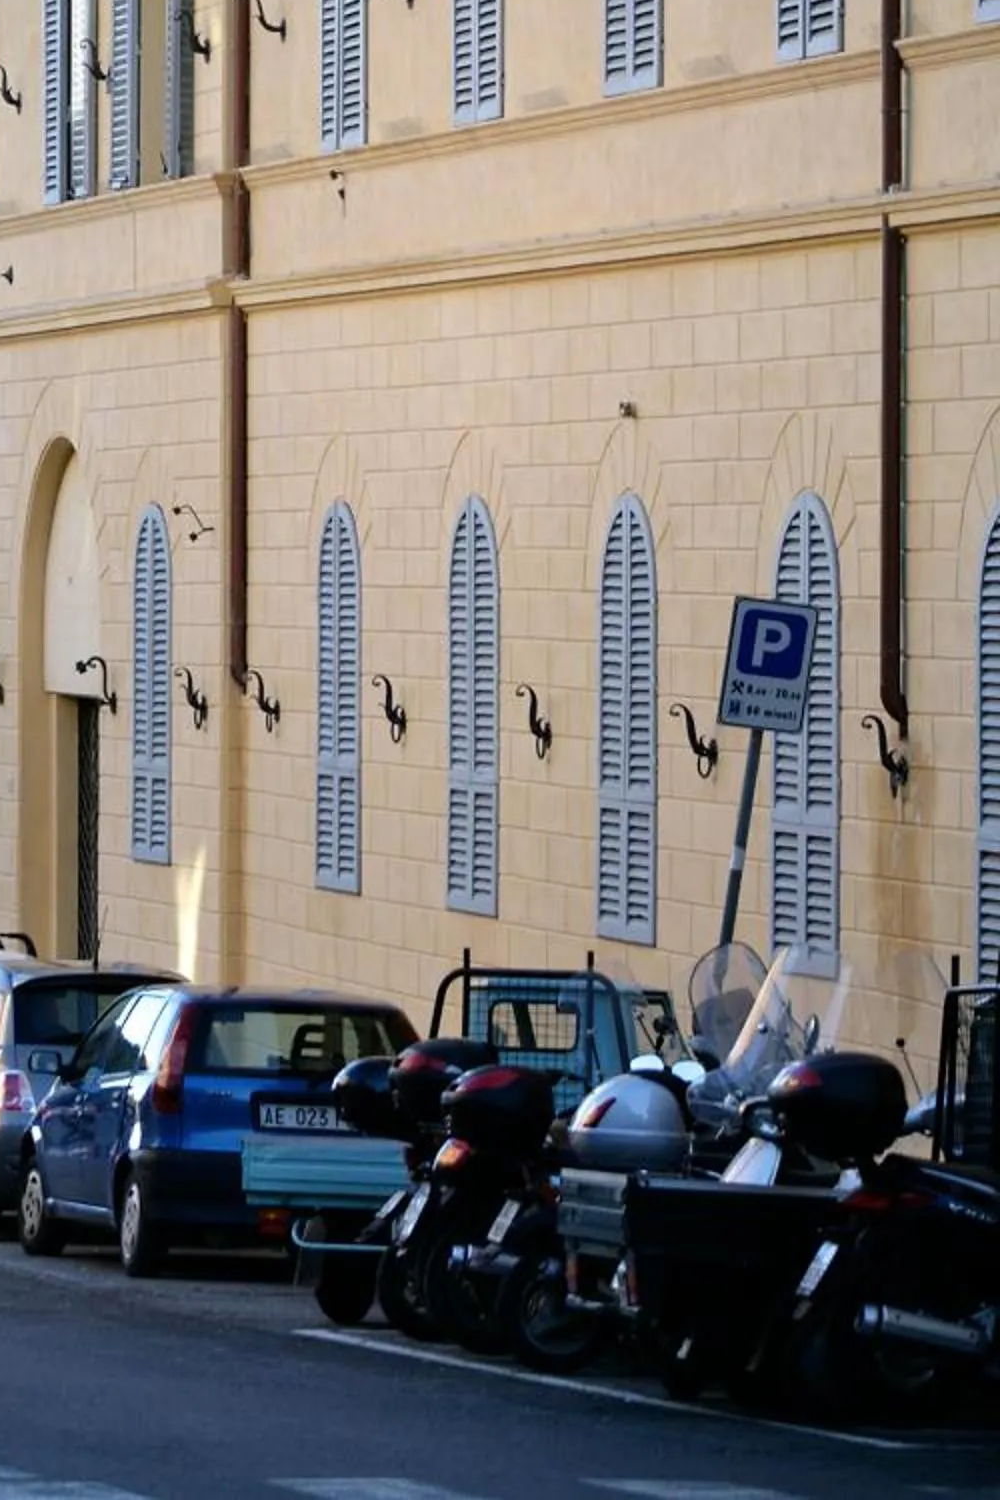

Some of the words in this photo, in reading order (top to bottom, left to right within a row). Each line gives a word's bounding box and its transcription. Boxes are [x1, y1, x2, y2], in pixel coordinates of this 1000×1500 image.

[751, 618, 792, 668] P
[264, 1106, 286, 1125] AE
[295, 1107, 329, 1127] 023
